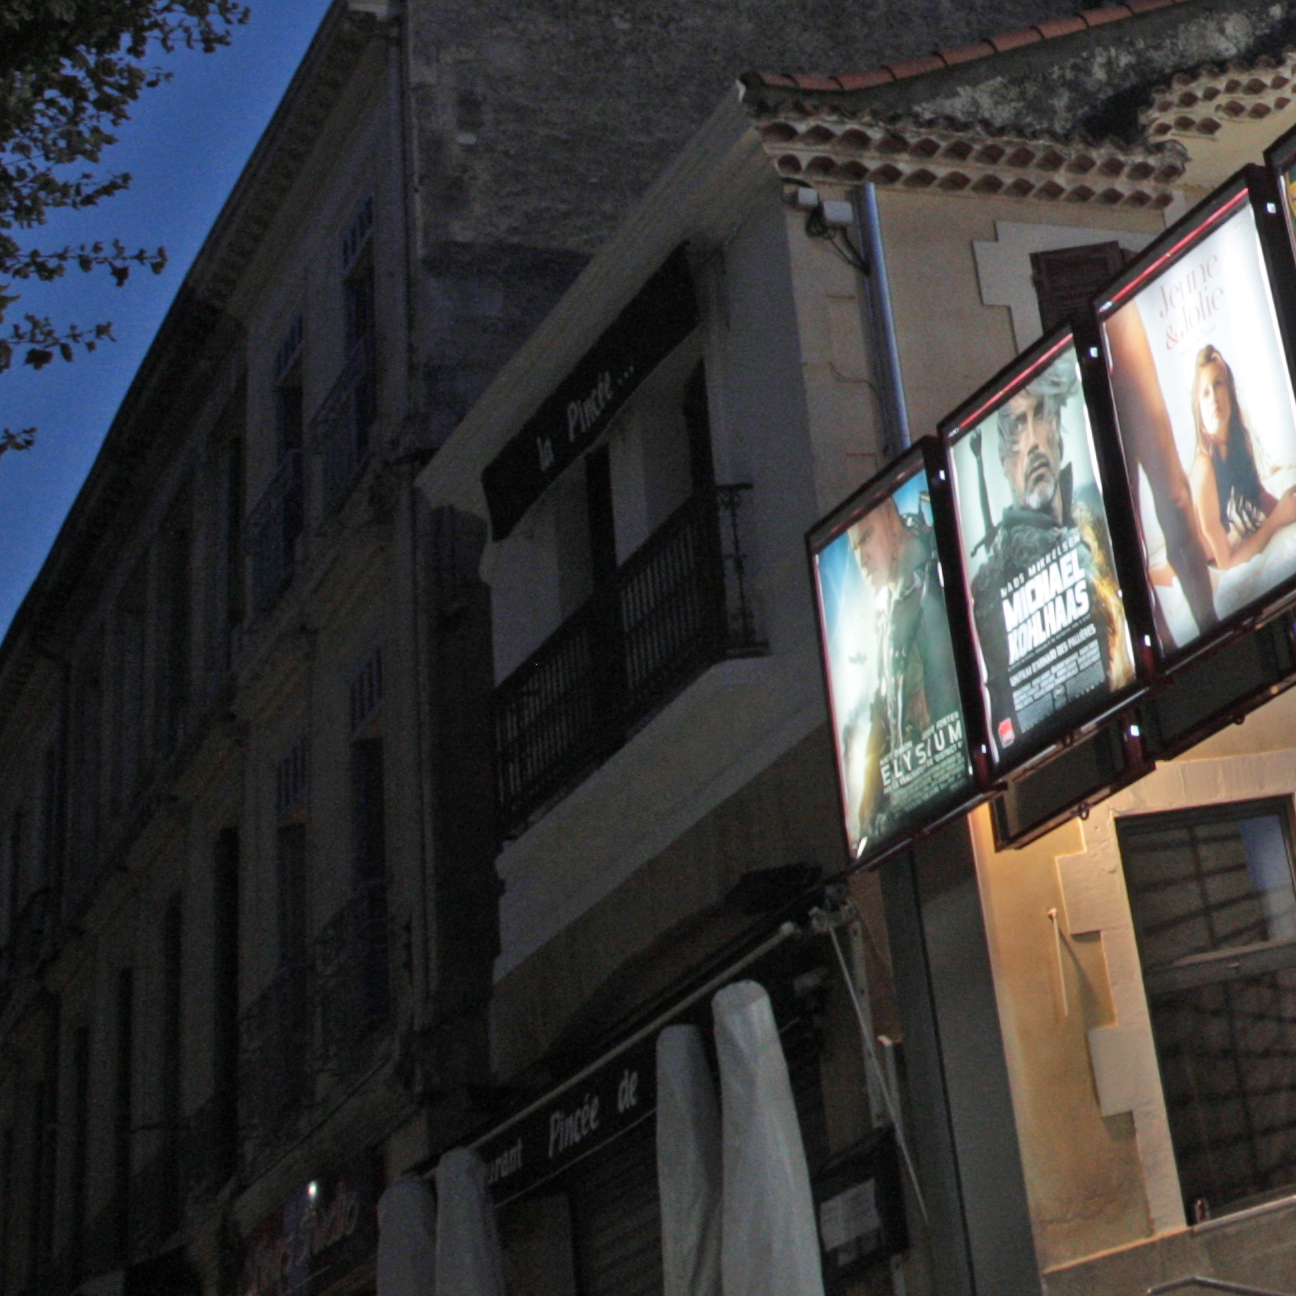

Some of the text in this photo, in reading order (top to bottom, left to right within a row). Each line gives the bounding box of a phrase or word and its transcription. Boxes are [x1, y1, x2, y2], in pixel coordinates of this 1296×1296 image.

[1157, 254, 1218, 319] Jeune
[1180, 285, 1225, 339] Jolie
[1002, 548, 1086, 634] MICHAEL
[1007, 579, 1090, 666] KOHLHAAS
[880, 719, 963, 787] ELYSIUM
[547, 1092, 601, 1160] Pincée
[616, 1068, 641, 1115] de
